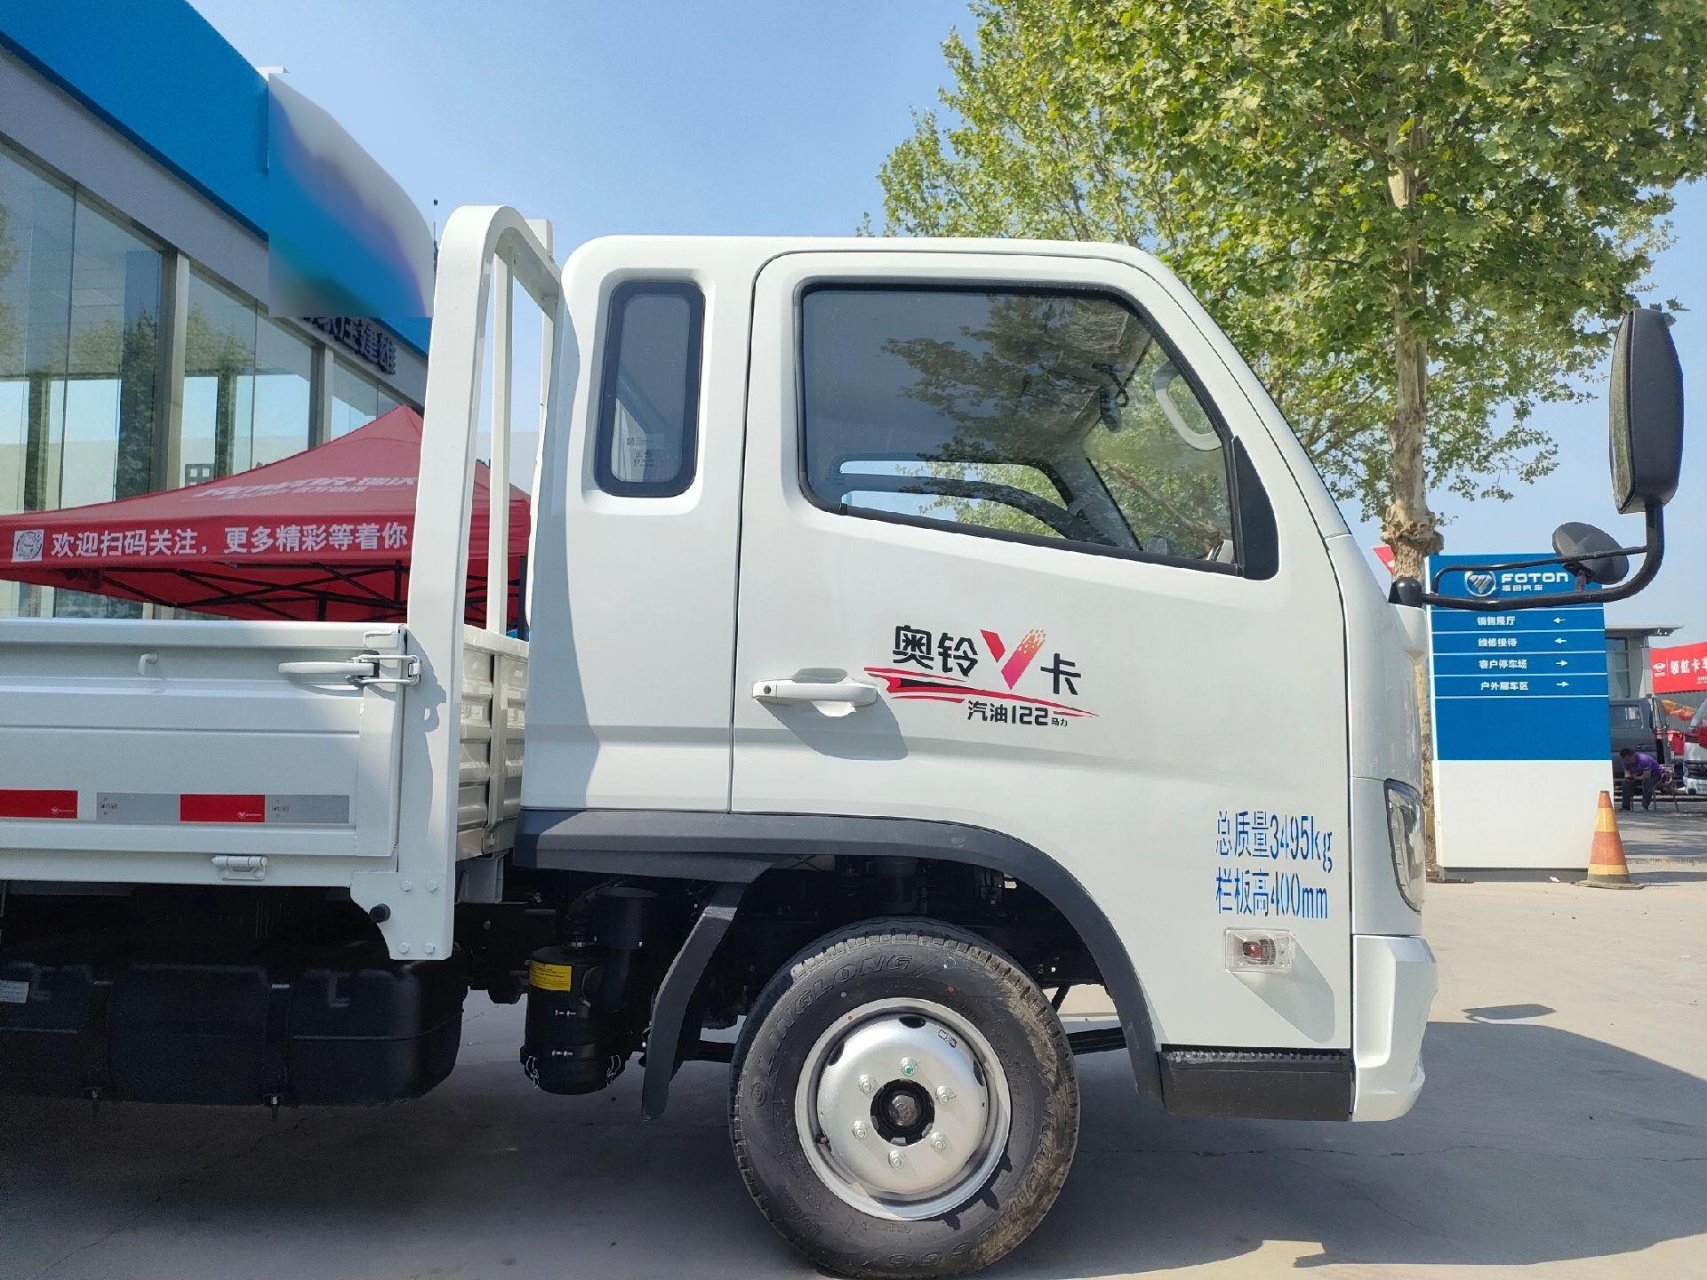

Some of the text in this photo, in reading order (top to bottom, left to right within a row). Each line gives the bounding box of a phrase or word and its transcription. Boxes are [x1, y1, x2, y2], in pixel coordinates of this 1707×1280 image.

[1501, 572, 1569, 583] FOTON
[1477, 616, 1515, 626] 销售展厅
[1478, 638, 1517, 647] 维修接待
[1479, 659, 1527, 669] 客户停车场
[1480, 682, 1529, 691] 户外展车区
[1216, 811, 1333, 873] 总质量3495kg
[1216, 867, 1328, 919] 栏板高400mm
[757, 954, 912, 1076] LINGLONG
